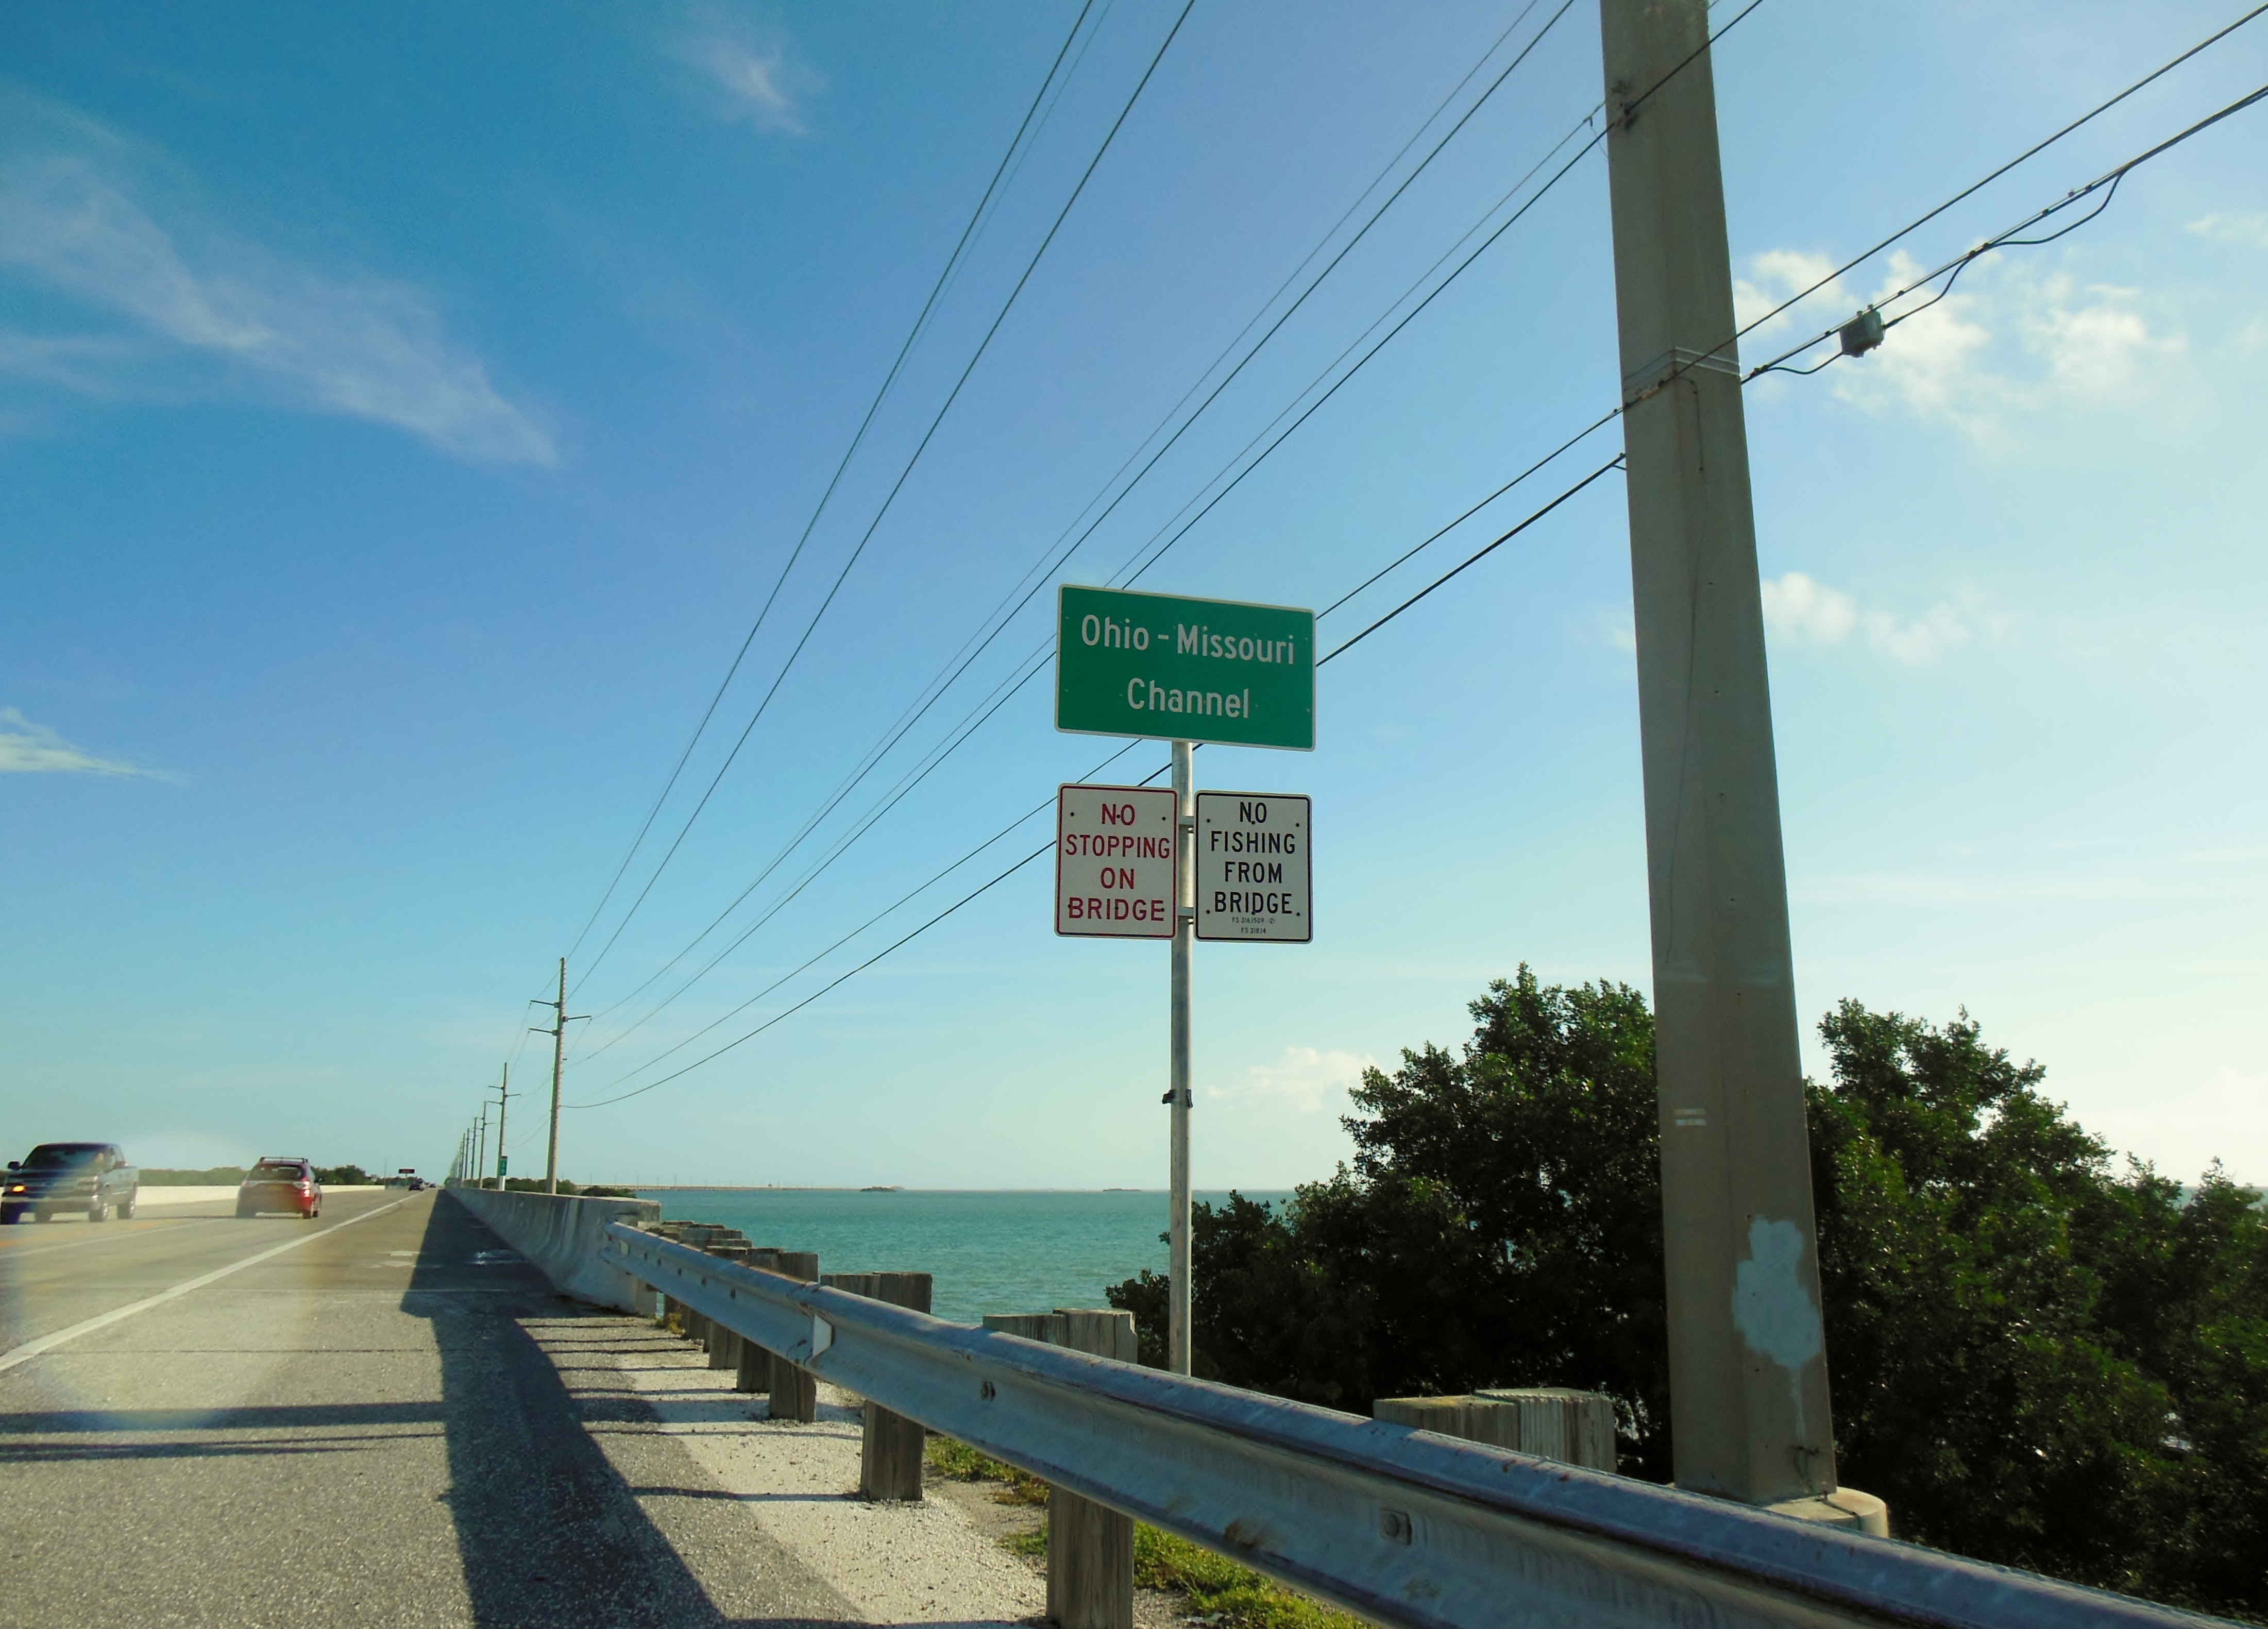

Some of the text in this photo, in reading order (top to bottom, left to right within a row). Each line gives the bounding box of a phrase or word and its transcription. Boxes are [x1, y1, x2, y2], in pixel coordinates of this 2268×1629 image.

[1081, 614, 1149, 651] Ohio
[1177, 623, 1294, 665] Missouri
[1128, 677, 1249, 719] Channel
[1101, 803, 1136, 826] NO
[1240, 802, 1267, 823] NO
[1065, 834, 1170, 859] STOPPING
[1211, 830, 1296, 854] FISHING
[1100, 867, 1135, 890] ON
[1224, 861, 1282, 884] FROM
[1068, 897, 1164, 922] BRIDGE
[1214, 891, 1292, 914] BRIDGE
